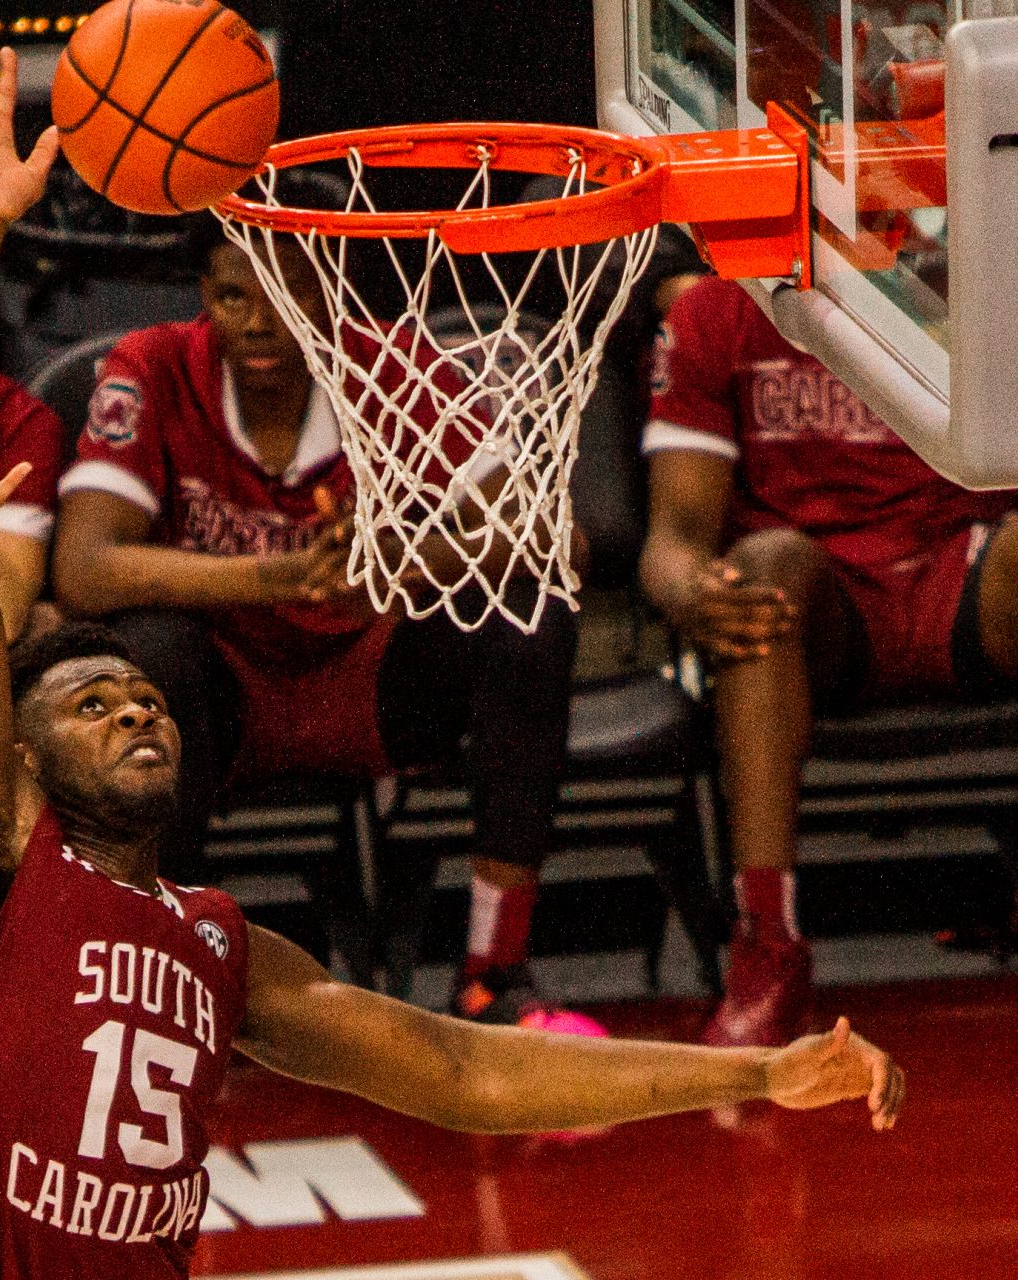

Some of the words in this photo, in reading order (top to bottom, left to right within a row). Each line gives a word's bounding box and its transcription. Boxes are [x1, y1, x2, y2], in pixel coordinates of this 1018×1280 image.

[74, 940, 216, 1055] SOUTH
[79, 1020, 198, 1169] 15
[6, 1140, 204, 1244] CAROLINA
